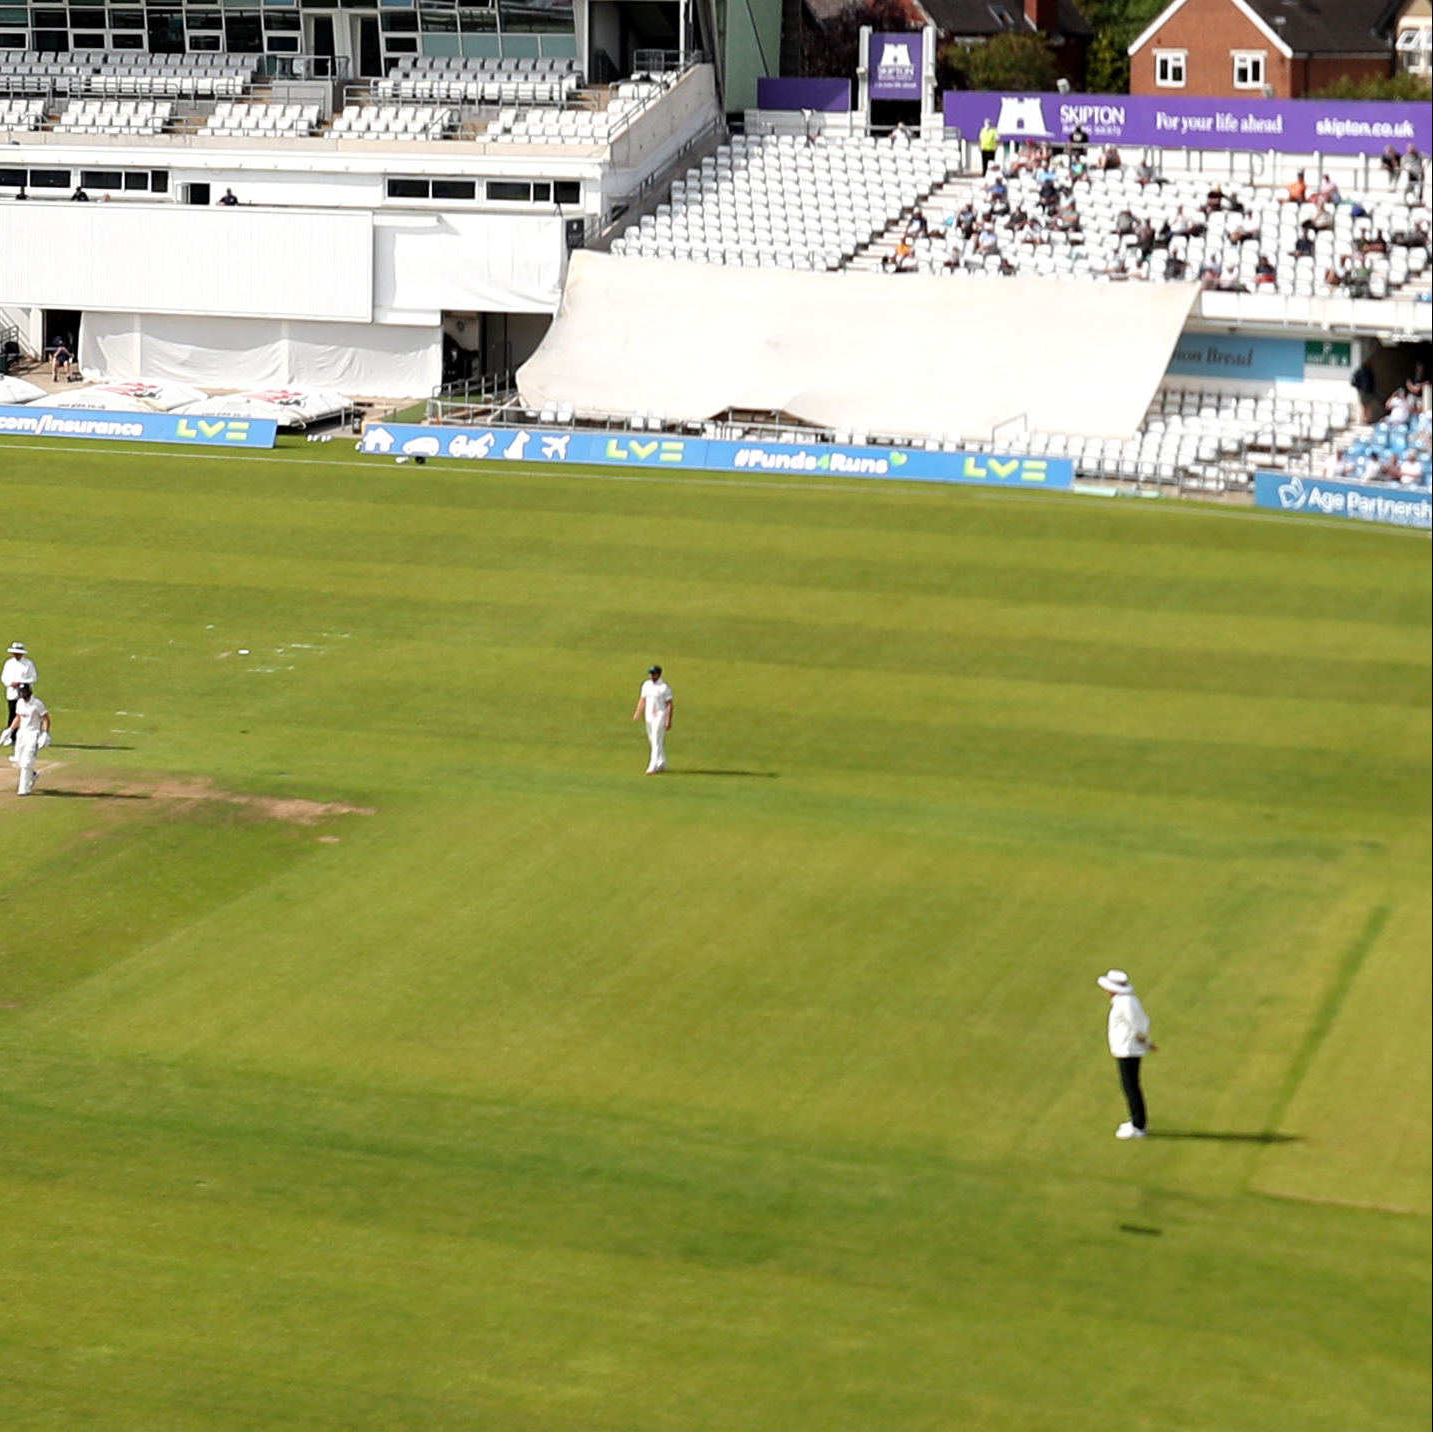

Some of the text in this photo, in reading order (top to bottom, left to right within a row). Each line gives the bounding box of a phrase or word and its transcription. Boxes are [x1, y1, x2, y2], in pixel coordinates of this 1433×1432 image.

[1060, 104, 1125, 126] SKIPTON
[1156, 111, 1283, 135] For your life ahead
[1316, 118, 1415, 139] skipton.co.uk
[734, 448, 889, 475] #Funds4Runs
[1307, 486, 1345, 513] Age
